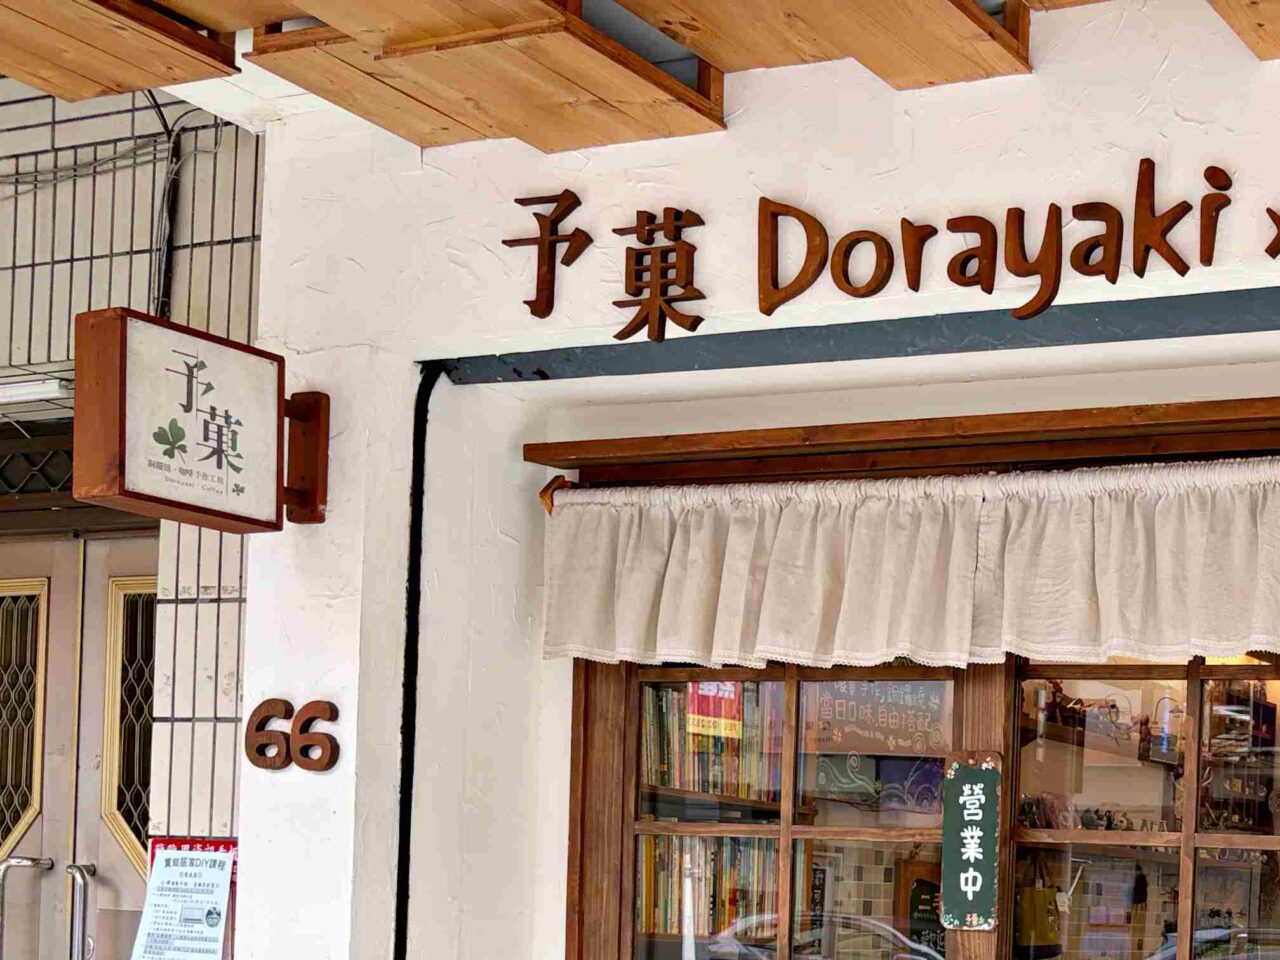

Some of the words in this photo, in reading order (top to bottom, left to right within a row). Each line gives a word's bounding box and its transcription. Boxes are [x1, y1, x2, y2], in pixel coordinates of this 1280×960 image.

[502, 188, 708, 344] 予菓
[759, 158, 1231, 320] Dorayaki
[245, 698, 340, 772] 66
[959, 782, 986, 901] 營業中
